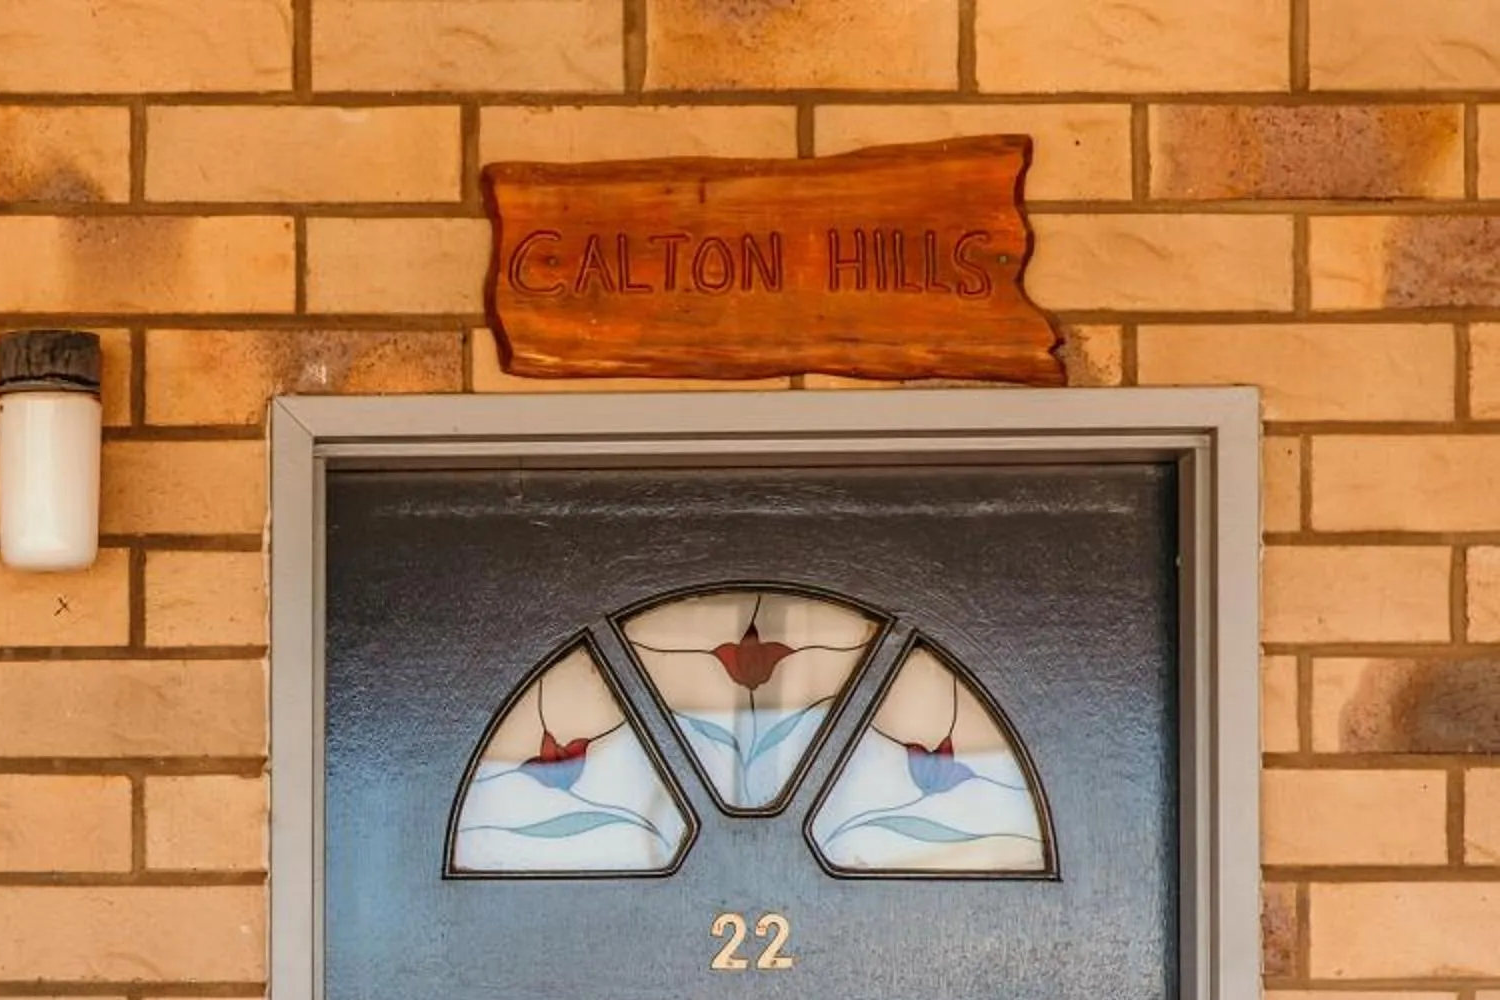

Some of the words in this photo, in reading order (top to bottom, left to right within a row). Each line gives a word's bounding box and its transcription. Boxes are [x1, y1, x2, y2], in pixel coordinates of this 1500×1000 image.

[507, 229, 783, 296] CALTON
[826, 228, 994, 298] HILLS
[710, 912, 794, 970] 22
